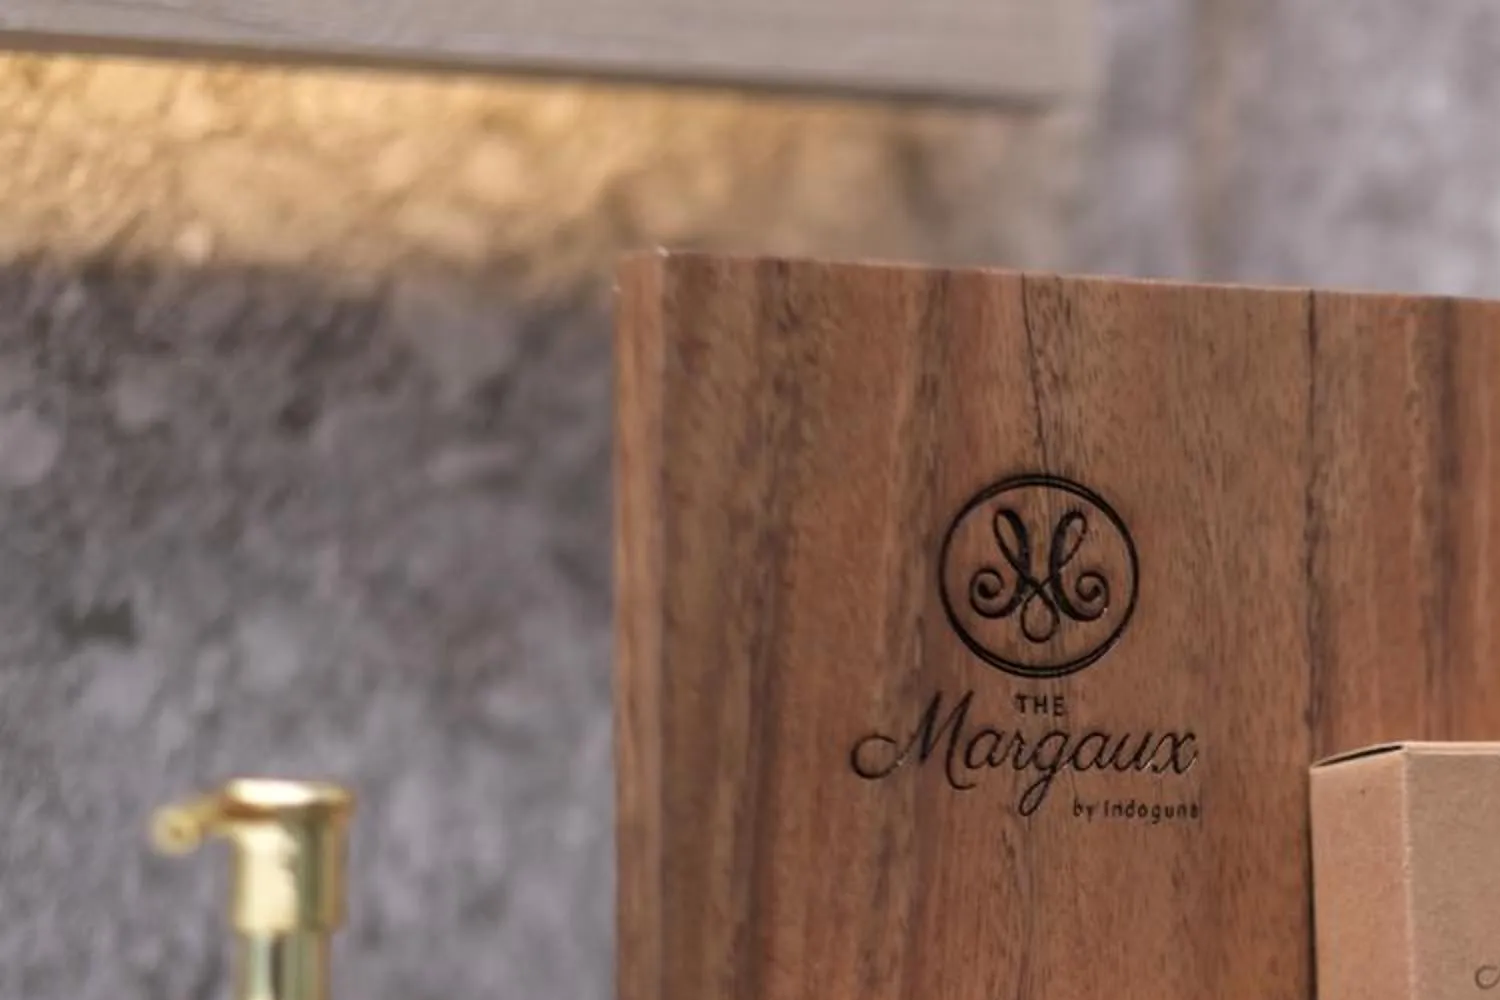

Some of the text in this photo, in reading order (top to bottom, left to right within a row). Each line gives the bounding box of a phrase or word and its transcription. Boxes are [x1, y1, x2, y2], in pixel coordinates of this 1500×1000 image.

[1014, 694, 1067, 717] THE
[850, 689, 1200, 817] Margaux
[1072, 798, 1099, 824] by
